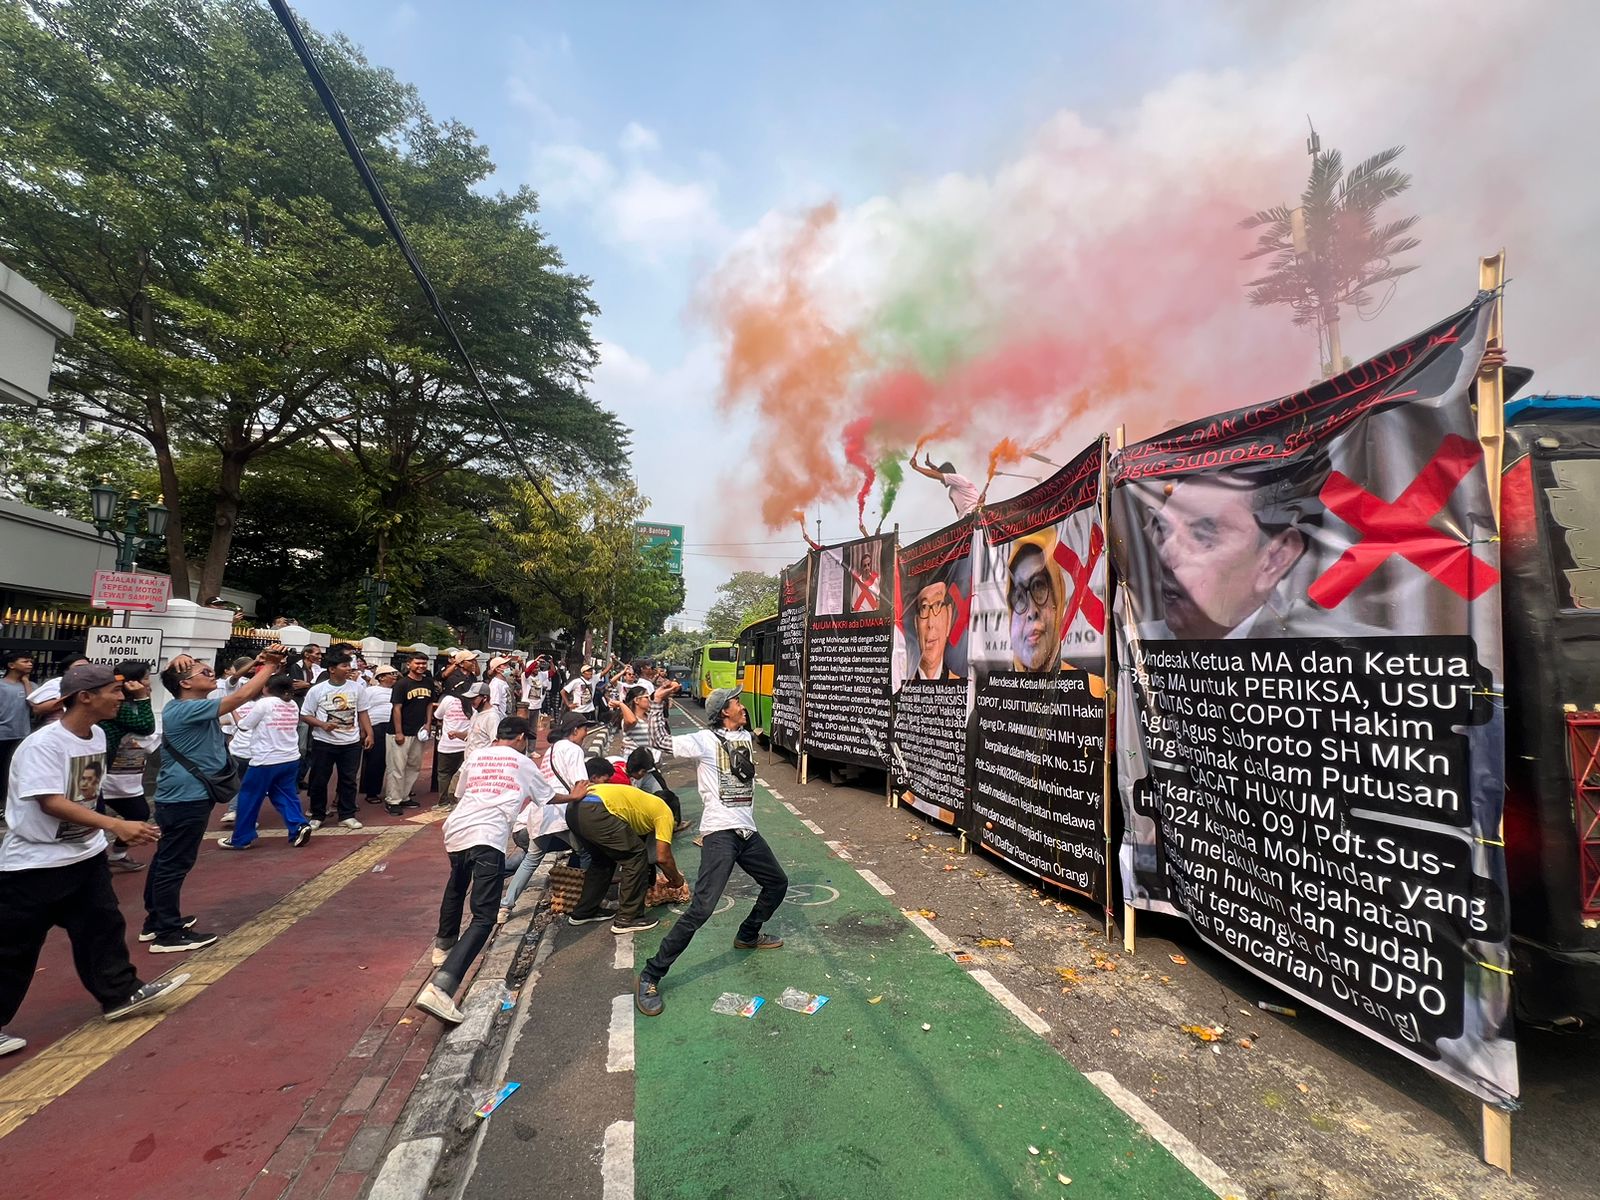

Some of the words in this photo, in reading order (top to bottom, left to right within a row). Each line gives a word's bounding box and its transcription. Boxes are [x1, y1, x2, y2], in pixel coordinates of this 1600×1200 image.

[98, 591, 126, 599] LEWAT
[128, 594, 163, 602] SAMPING
[100, 575, 136, 585] PEJALAN
[139, 578, 158, 587] KAKI
[102, 584, 132, 592] SEPEDA
[136, 585, 162, 594] MOTOR
[96, 635, 123, 644] KACA
[126, 636, 153, 645] PINTU
[109, 647, 139, 656] MOBIL
[1191, 651, 1242, 672] Ketua
[1251, 651, 1293, 673] MA
[1301, 650, 1354, 675] dan
[1365, 651, 1470, 677] Ketua
[989, 676, 1018, 689] Mendesak
[1020, 678, 1038, 690] Ketua
[1058, 679, 1085, 693] segera
[1168, 673, 1187, 692] MA
[1190, 676, 1239, 697] untuk
[1244, 676, 1370, 709] PERIKSA,
[1380, 683, 1475, 711] USUT
[1003, 699, 1020, 711] USUT
[1021, 700, 1042, 714] TUNTAS
[1197, 698, 1227, 720] dan
[1230, 701, 1322, 732] COPOT
[1331, 709, 1434, 741] Hakim
[979, 716, 997, 733] Agung
[997, 720, 1007, 732] Dr.
[1046, 728, 1057, 741] SH
[1059, 730, 1075, 744] MH
[1182, 719, 1217, 745] Agus
[1222, 725, 1312, 758] Subroto
[1320, 738, 1361, 765] SH
[1371, 741, 1451, 776] MKn
[1042, 754, 1054, 768] PK
[1055, 756, 1071, 771] No.
[1073, 759, 1087, 773] 15
[1178, 742, 1239, 772] berpihak
[1244, 754, 1312, 788] dalam
[1322, 766, 1459, 811] Putusan
[1039, 778, 1085, 800] Mohindar
[1190, 765, 1239, 796] CACAT
[1245, 779, 1336, 821] HUKUM
[988, 807, 1000, 822] dan
[1000, 815, 1017, 831] sudah
[1018, 824, 1042, 843] menjadi
[1043, 833, 1093, 859] tersangka
[1204, 792, 1225, 816] PK
[1224, 799, 1256, 828] No.
[1262, 810, 1295, 838] 09
[1314, 824, 1456, 875] Pdt.Sus-
[1015, 845, 1052, 873] Pencarian
[1053, 862, 1089, 888] Orang)
[1205, 812, 1258, 854] kepada
[1263, 836, 1392, 894] Mohindar
[1400, 879, 1487, 932] yang
[1191, 837, 1283, 890] melakukan
[1290, 876, 1434, 943] kejahatan
[1224, 868, 1287, 916] hukum
[1290, 902, 1337, 940] dan
[1344, 925, 1445, 981] sudah
[1209, 891, 1311, 955] tersangka
[1315, 943, 1361, 982] dan
[1371, 963, 1447, 1016] DPO
[1213, 916, 1326, 988] Pencarian
